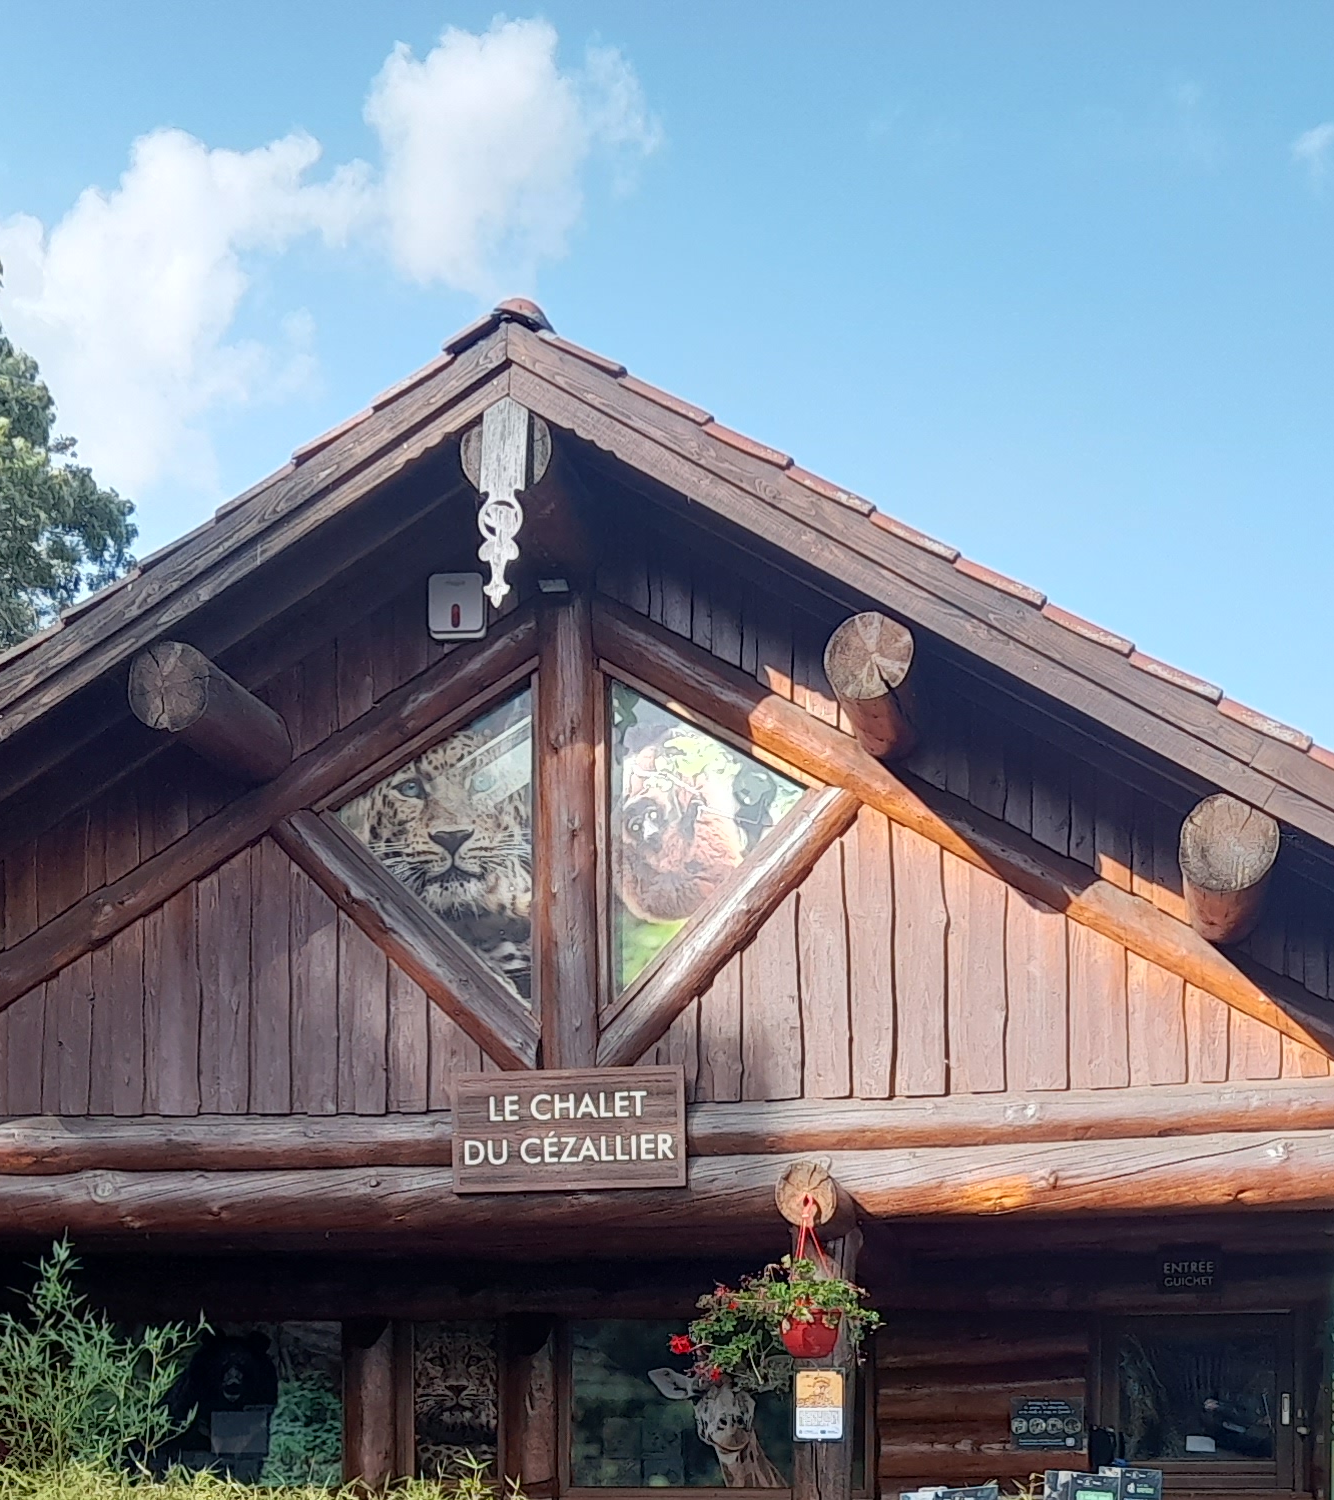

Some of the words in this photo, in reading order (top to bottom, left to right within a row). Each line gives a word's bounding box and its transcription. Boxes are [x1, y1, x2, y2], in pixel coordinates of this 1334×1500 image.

[488, 1095, 520, 1122] LE
[530, 1090, 648, 1121] CHALET
[463, 1139, 509, 1166] DU
[520, 1131, 675, 1165] CÉZALLIER
[1164, 1276, 1214, 1287] GUICHET
